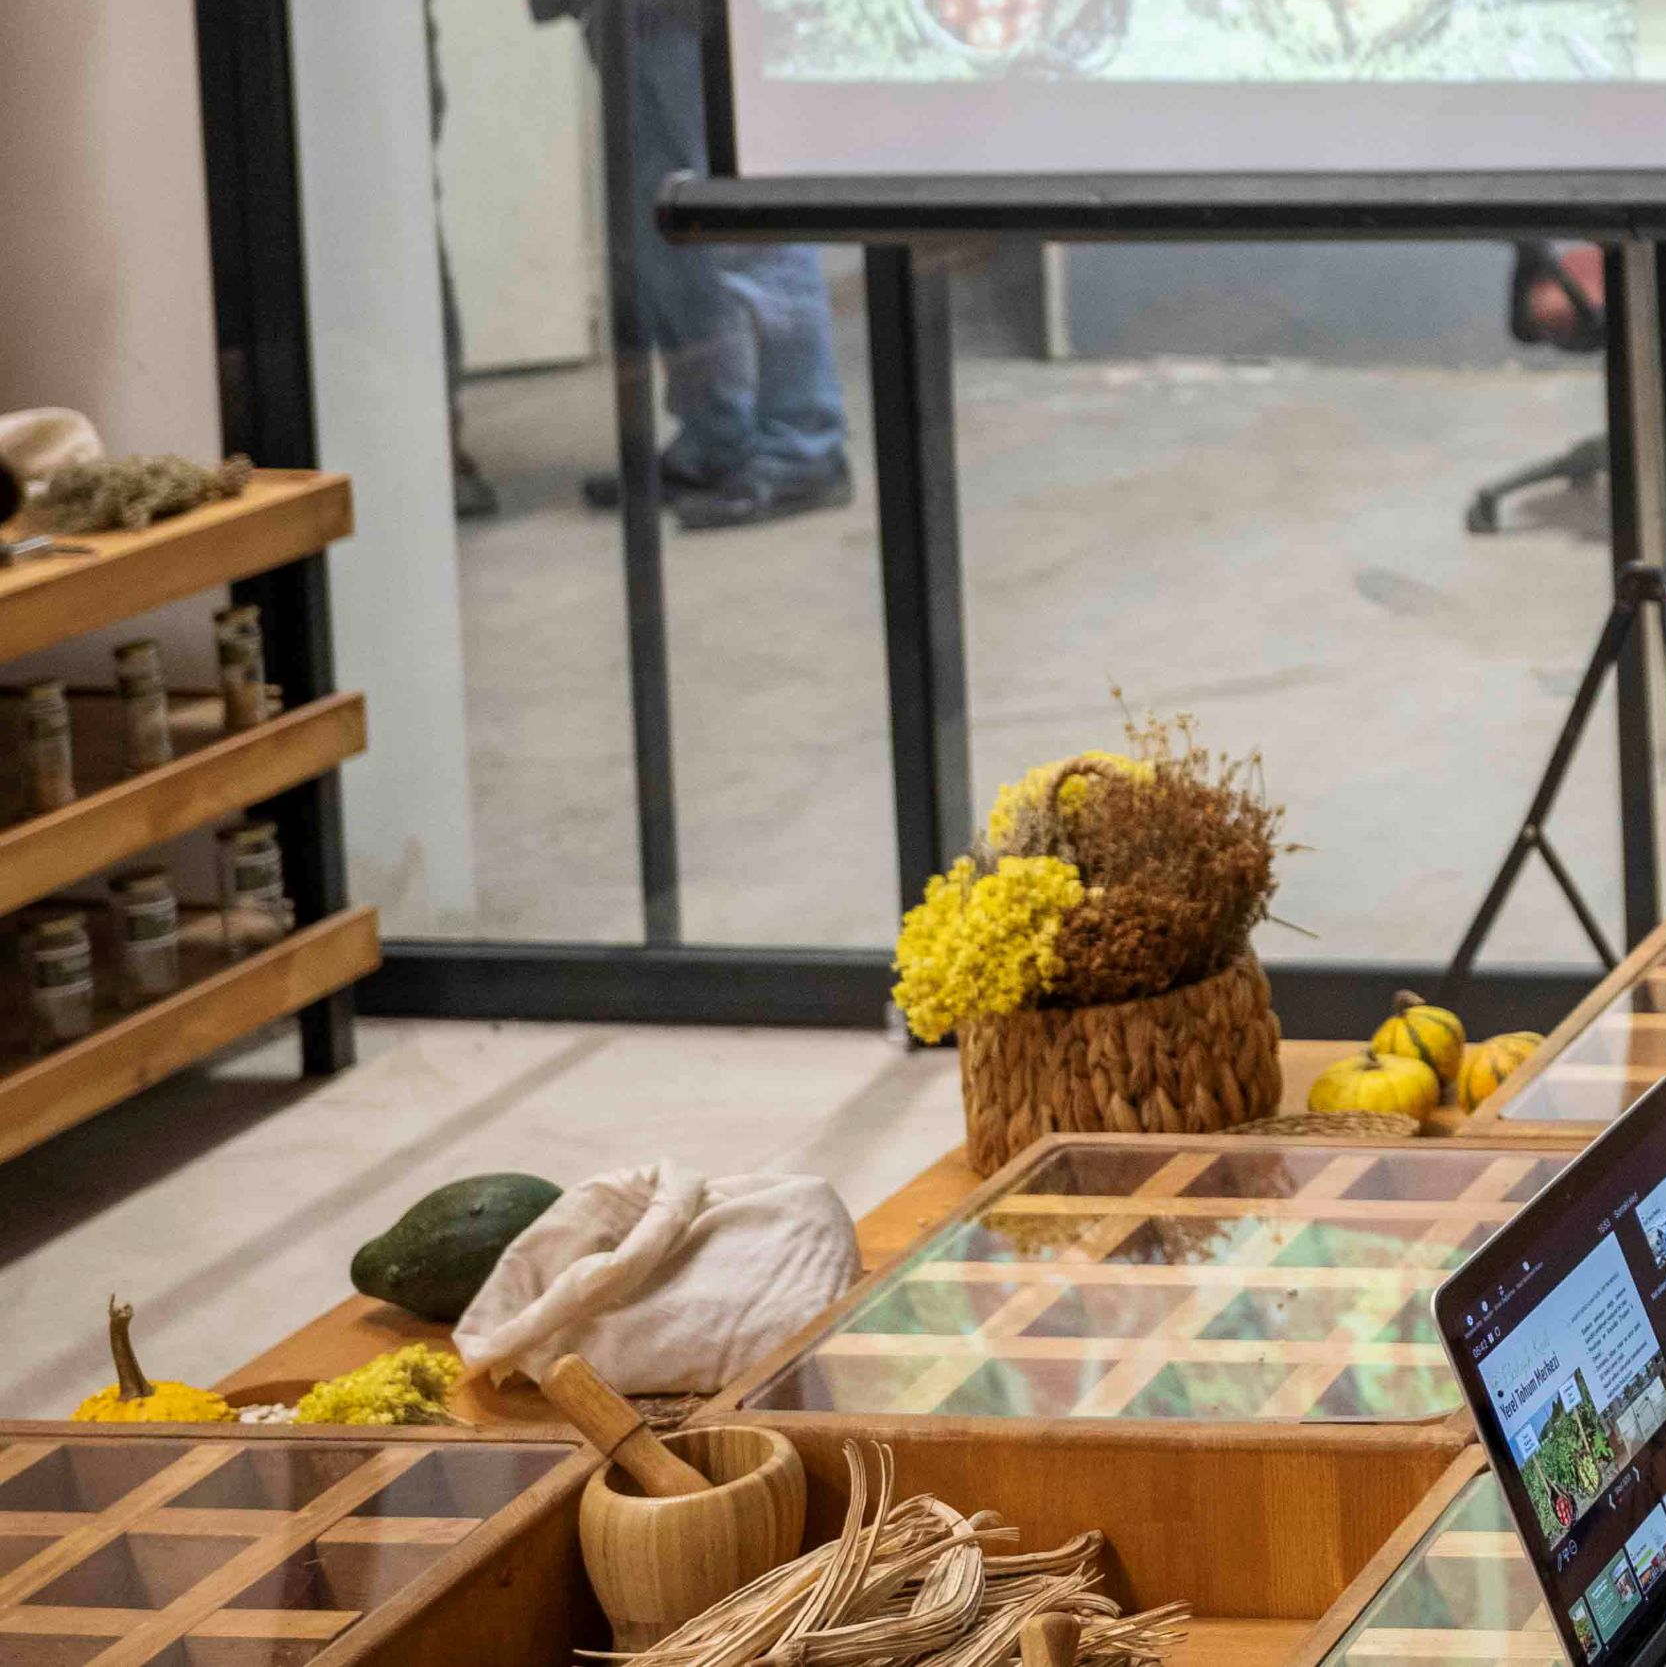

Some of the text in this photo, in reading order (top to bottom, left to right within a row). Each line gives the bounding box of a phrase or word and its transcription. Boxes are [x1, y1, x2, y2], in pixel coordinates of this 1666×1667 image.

[1500, 1351, 1561, 1421] Yerel Tohum Merkezi
